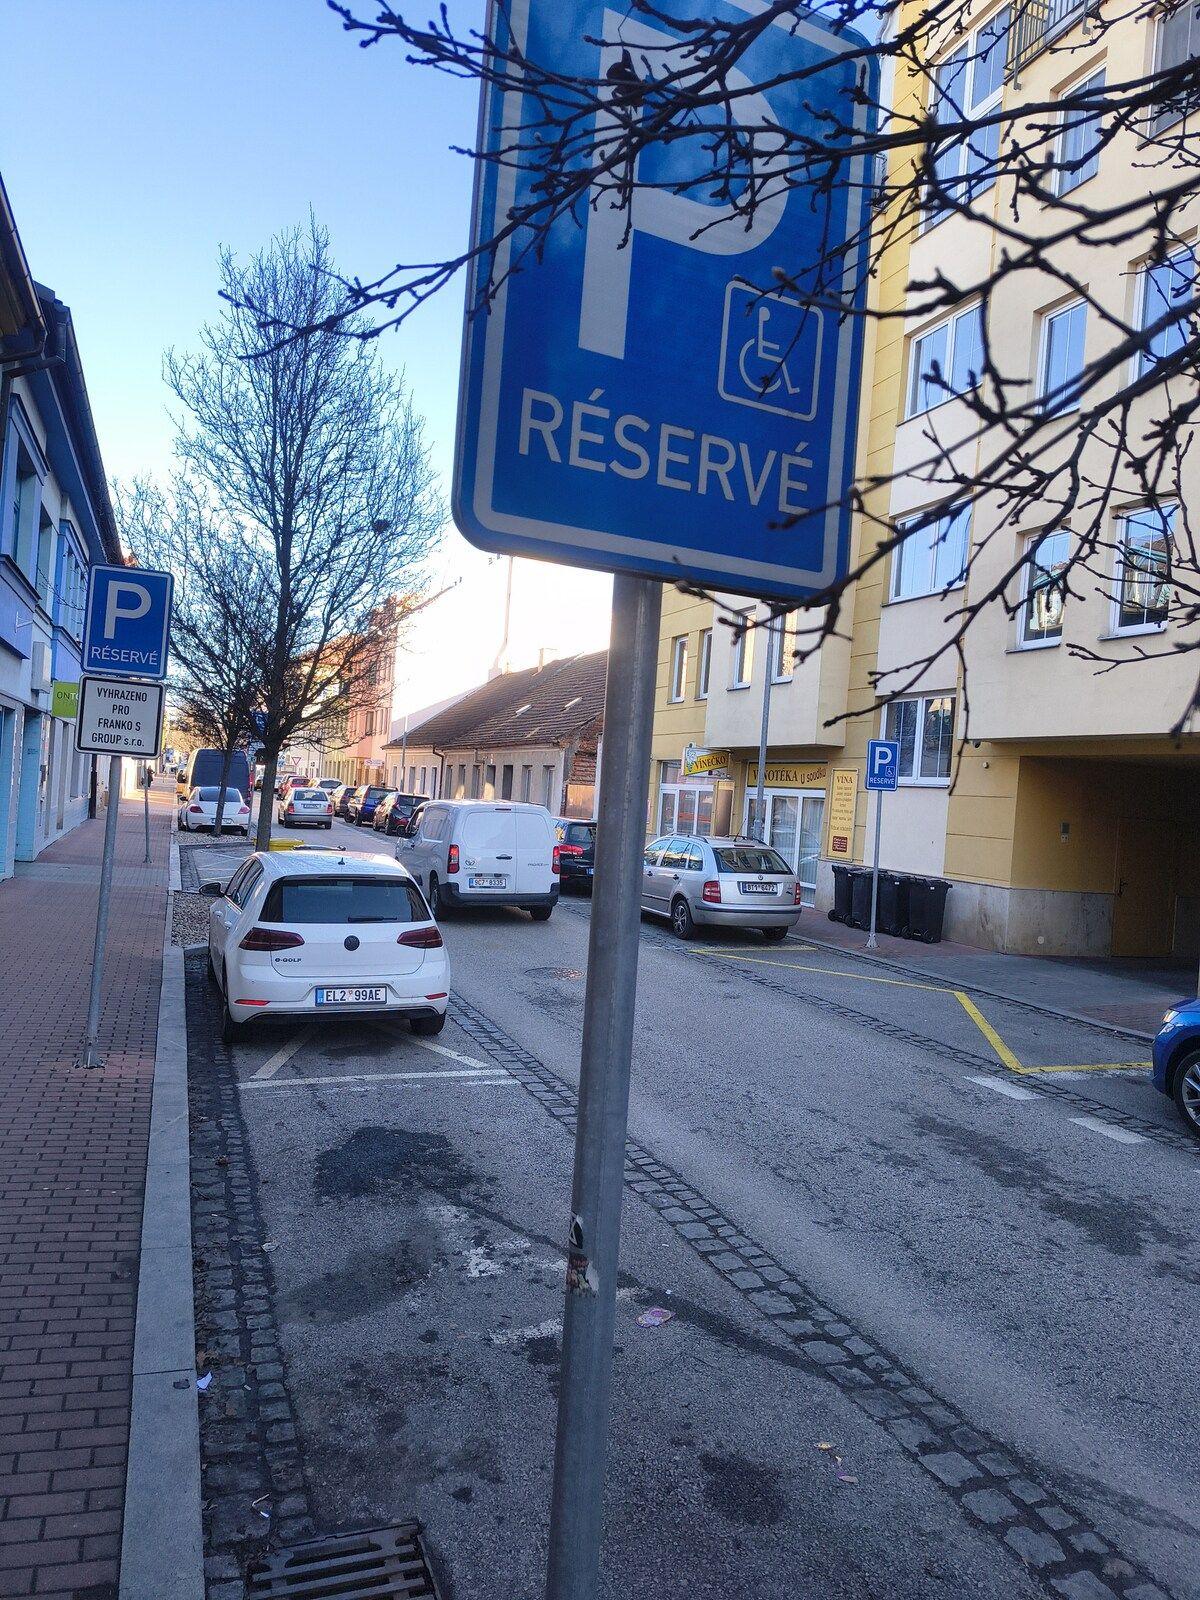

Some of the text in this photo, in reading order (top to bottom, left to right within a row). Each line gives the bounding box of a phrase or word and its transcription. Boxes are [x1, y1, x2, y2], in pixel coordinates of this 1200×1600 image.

[578, 7, 790, 360] P
[519, 387, 813, 515] RÉSERVÉ
[104, 580, 152, 640] P
[91, 645, 159, 665] RÉSERVÉ
[97, 687, 147, 702] VYHRAZENO
[112, 704, 130, 716] PRO
[97, 717, 141, 732] FRANKO S
[91, 732, 145, 747] GROUP s.r.o.
[874, 747, 892, 774] P
[753, 767, 798, 782] VNOTÉKA
[325, 989, 381, 1001] EL2 99AE
